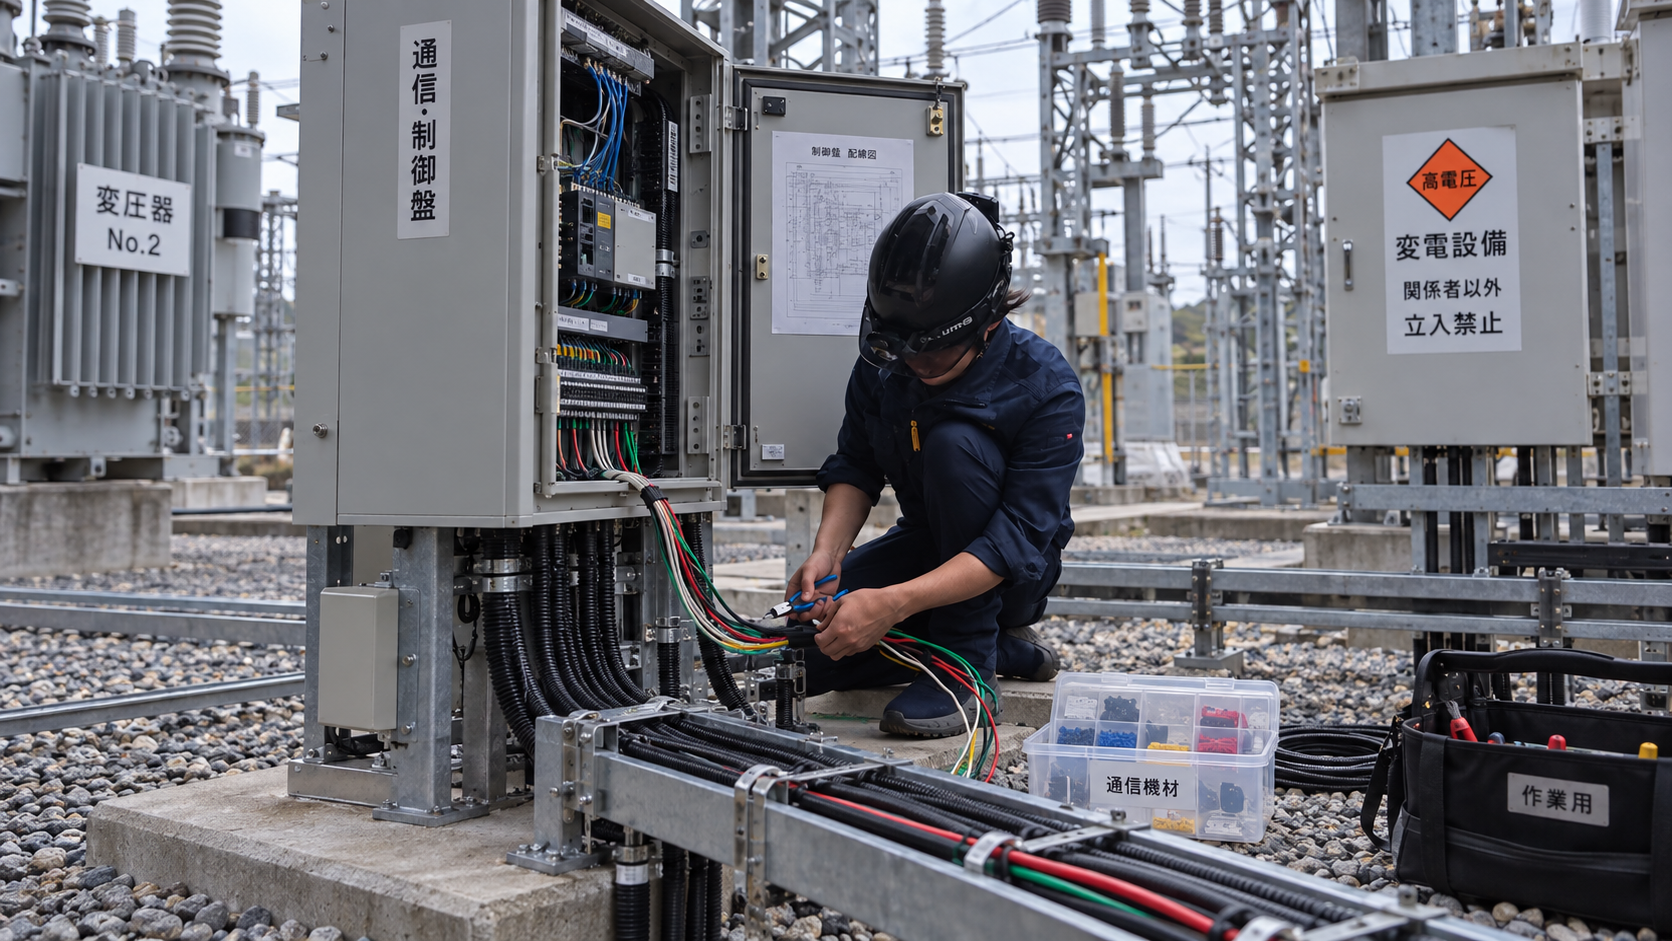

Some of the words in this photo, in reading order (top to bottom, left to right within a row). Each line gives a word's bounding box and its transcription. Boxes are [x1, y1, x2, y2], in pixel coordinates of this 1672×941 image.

[411, 38, 437, 221] 通信・制御盤
[1422, 169, 1477, 191] 高電圧
[96, 185, 173, 224] 変圧器
[108, 227, 161, 256] No.2
[1396, 229, 1507, 261] 変電設備
[1404, 278, 1502, 301] 関係者以外
[1404, 311, 1503, 336] 立入禁止
[1106, 776, 1179, 797] 通信機材
[1522, 784, 1592, 815] 作業用
